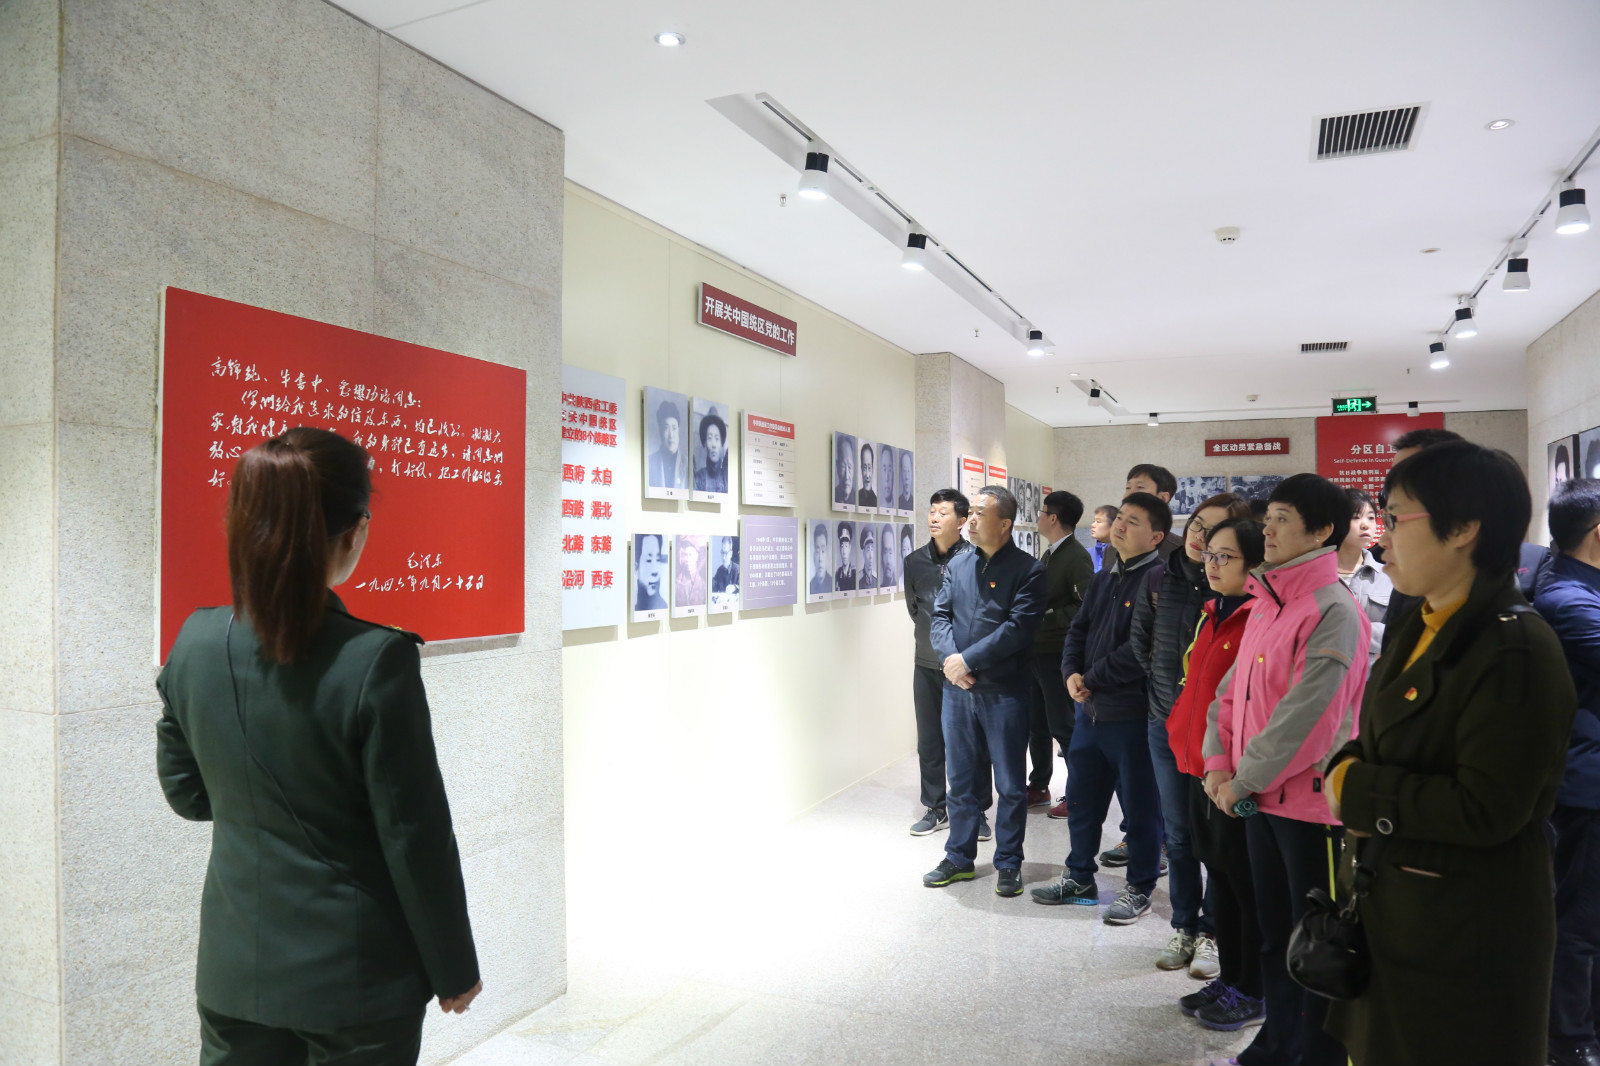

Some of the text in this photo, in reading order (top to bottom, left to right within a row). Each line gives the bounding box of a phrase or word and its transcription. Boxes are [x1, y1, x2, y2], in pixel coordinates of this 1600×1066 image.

[704, 295, 795, 346] 开展关中国统区党的工作
[1212, 441, 1281, 452] 全区动员紧急备战
[1350, 444, 1397, 455] 分区自卫
[562, 463, 613, 484] 西府 太白
[562, 498, 612, 518] 西路 渭北
[562, 534, 612, 552] 北路 东路
[562, 569, 613, 587] 沿河 西安
